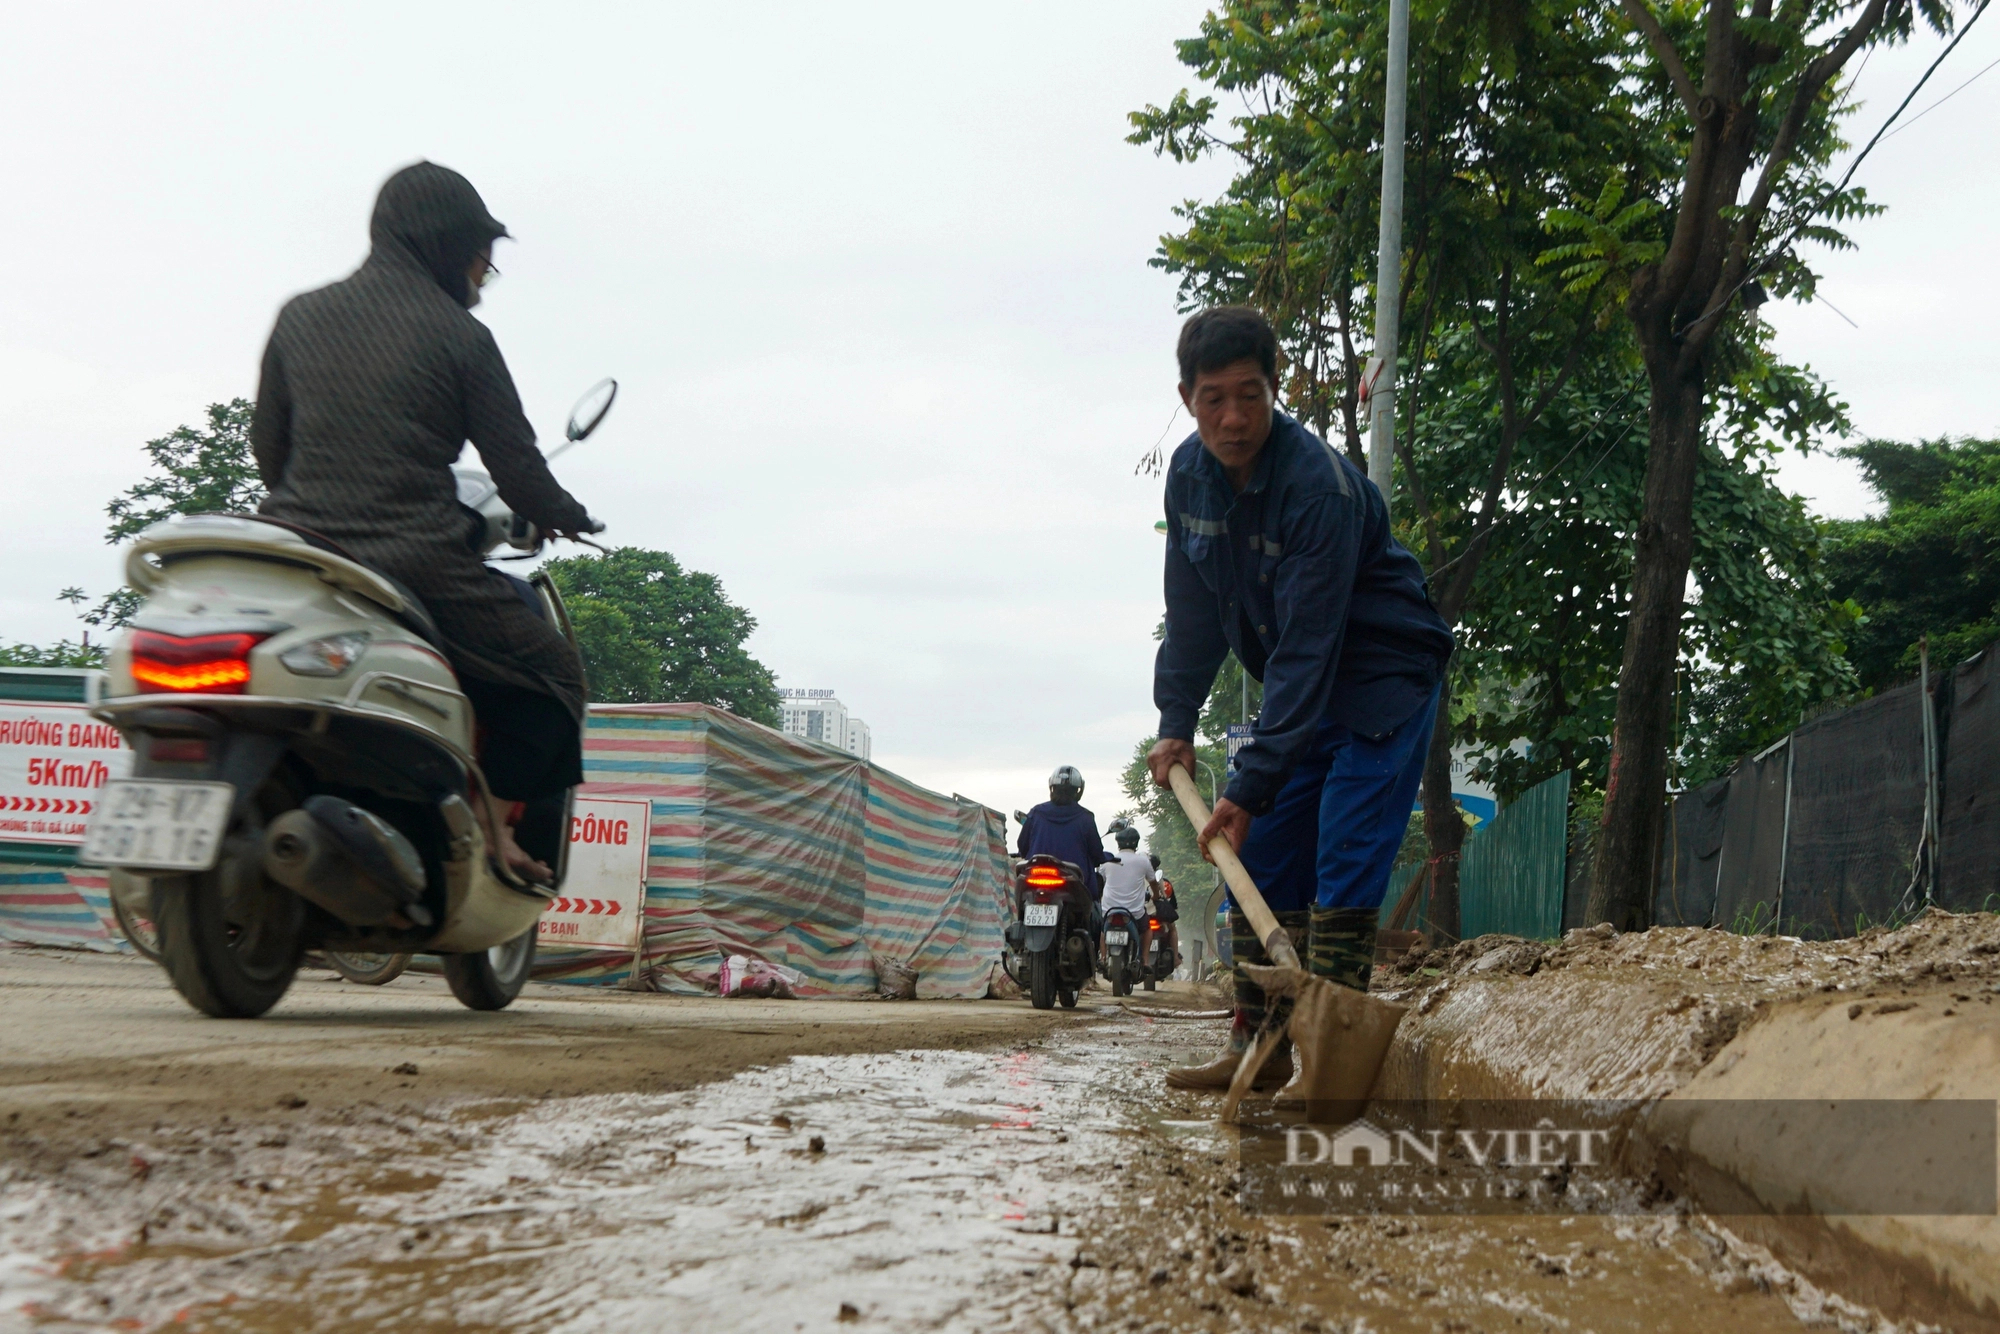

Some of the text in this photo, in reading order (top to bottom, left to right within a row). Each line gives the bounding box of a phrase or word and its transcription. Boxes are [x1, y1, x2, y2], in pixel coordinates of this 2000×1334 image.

[808, 689, 834, 698] GROUP
[68, 723, 120, 749] ĐANG
[27, 758, 109, 789] 5Km/h
[569, 812, 629, 845] CÔNG
